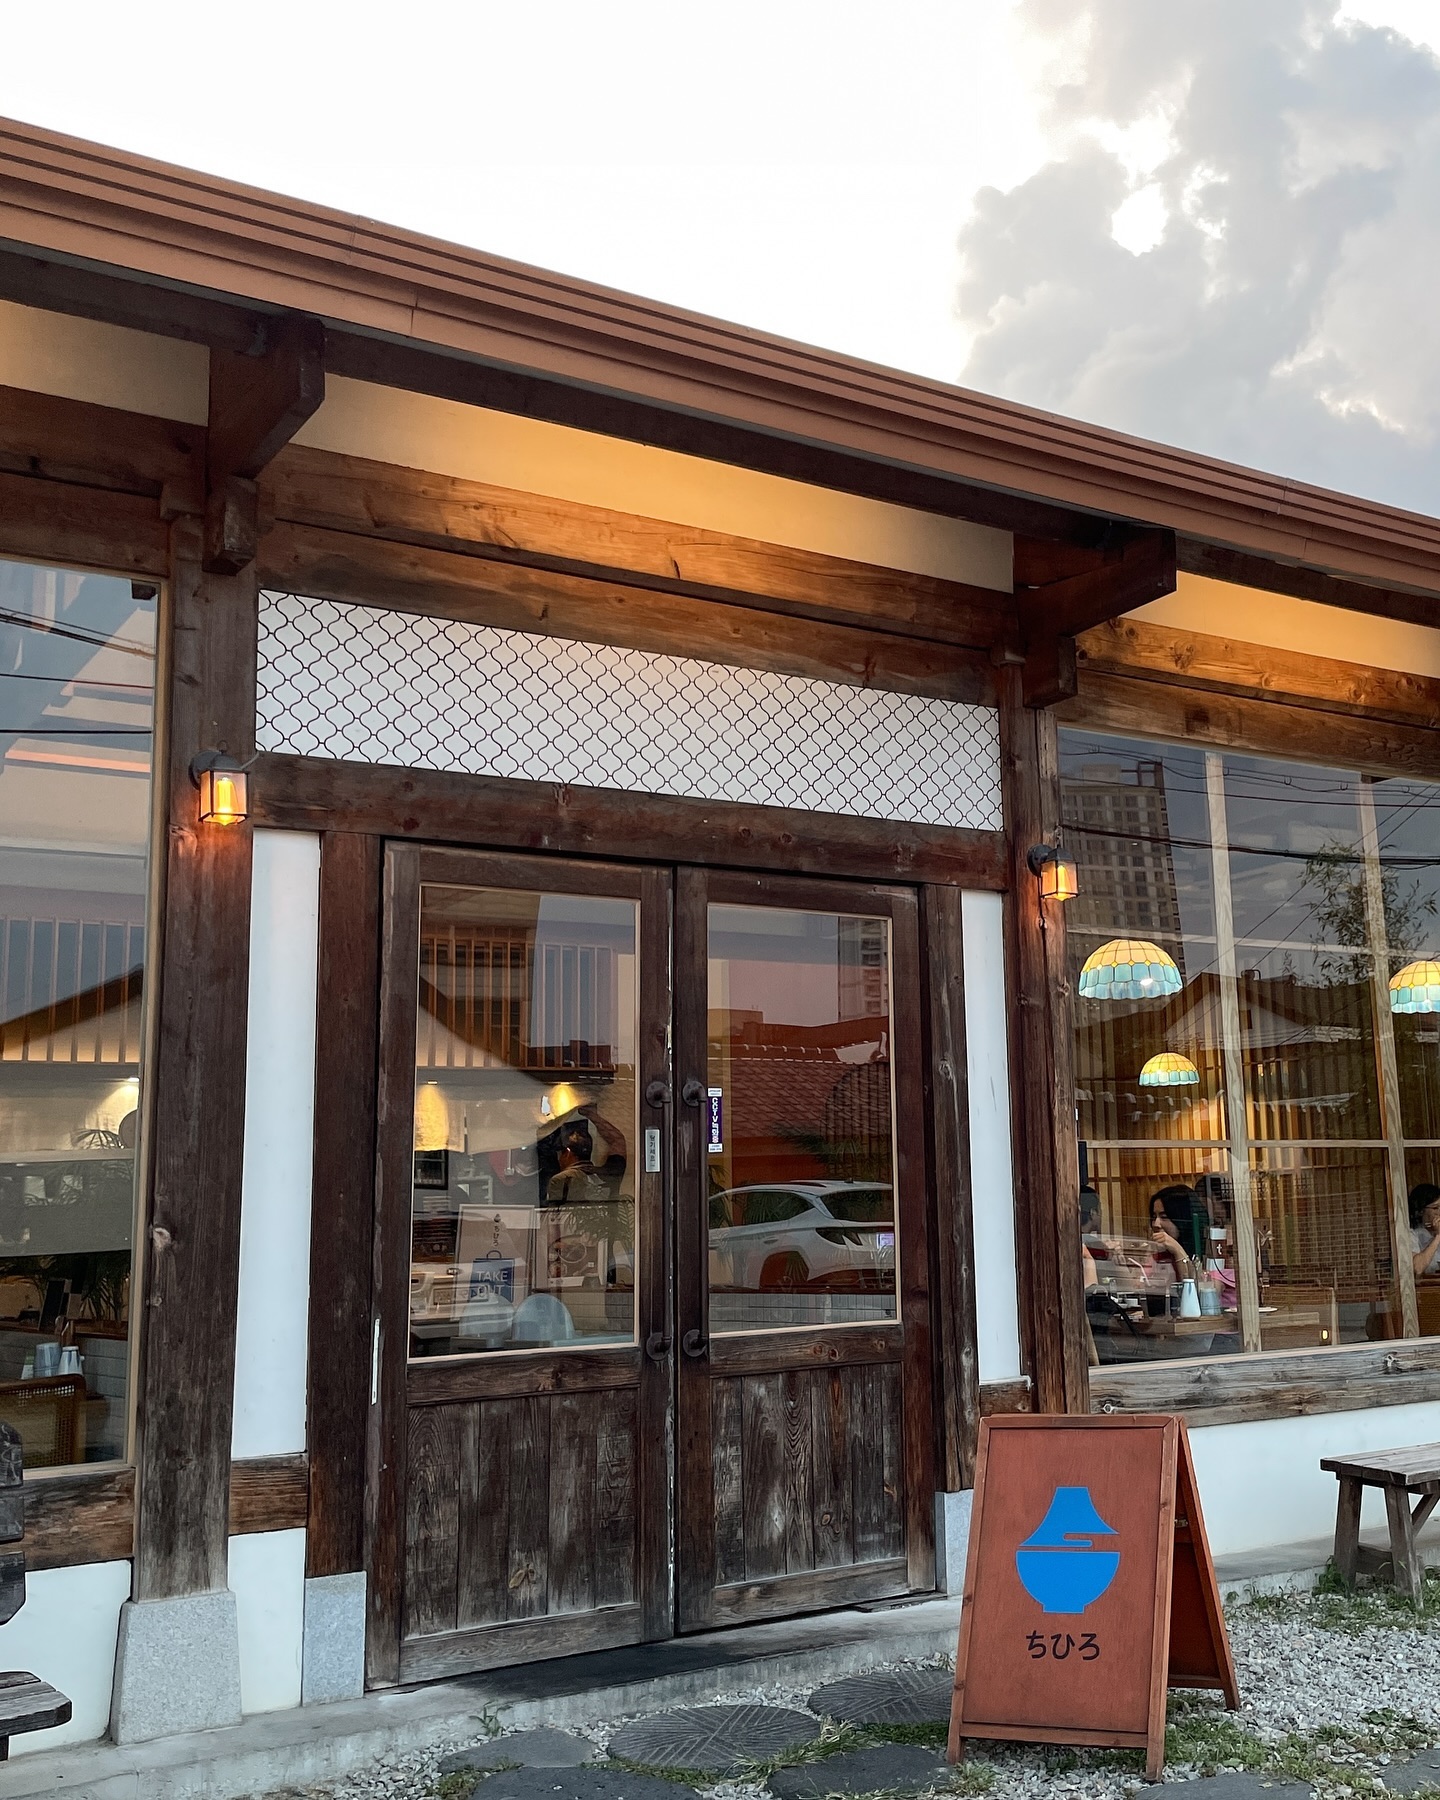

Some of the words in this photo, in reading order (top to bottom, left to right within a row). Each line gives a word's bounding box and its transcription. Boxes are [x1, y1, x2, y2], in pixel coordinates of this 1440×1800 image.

[476, 1270, 509, 1282] TAKE
[1025, 1629, 1100, 1661] ちひろ
